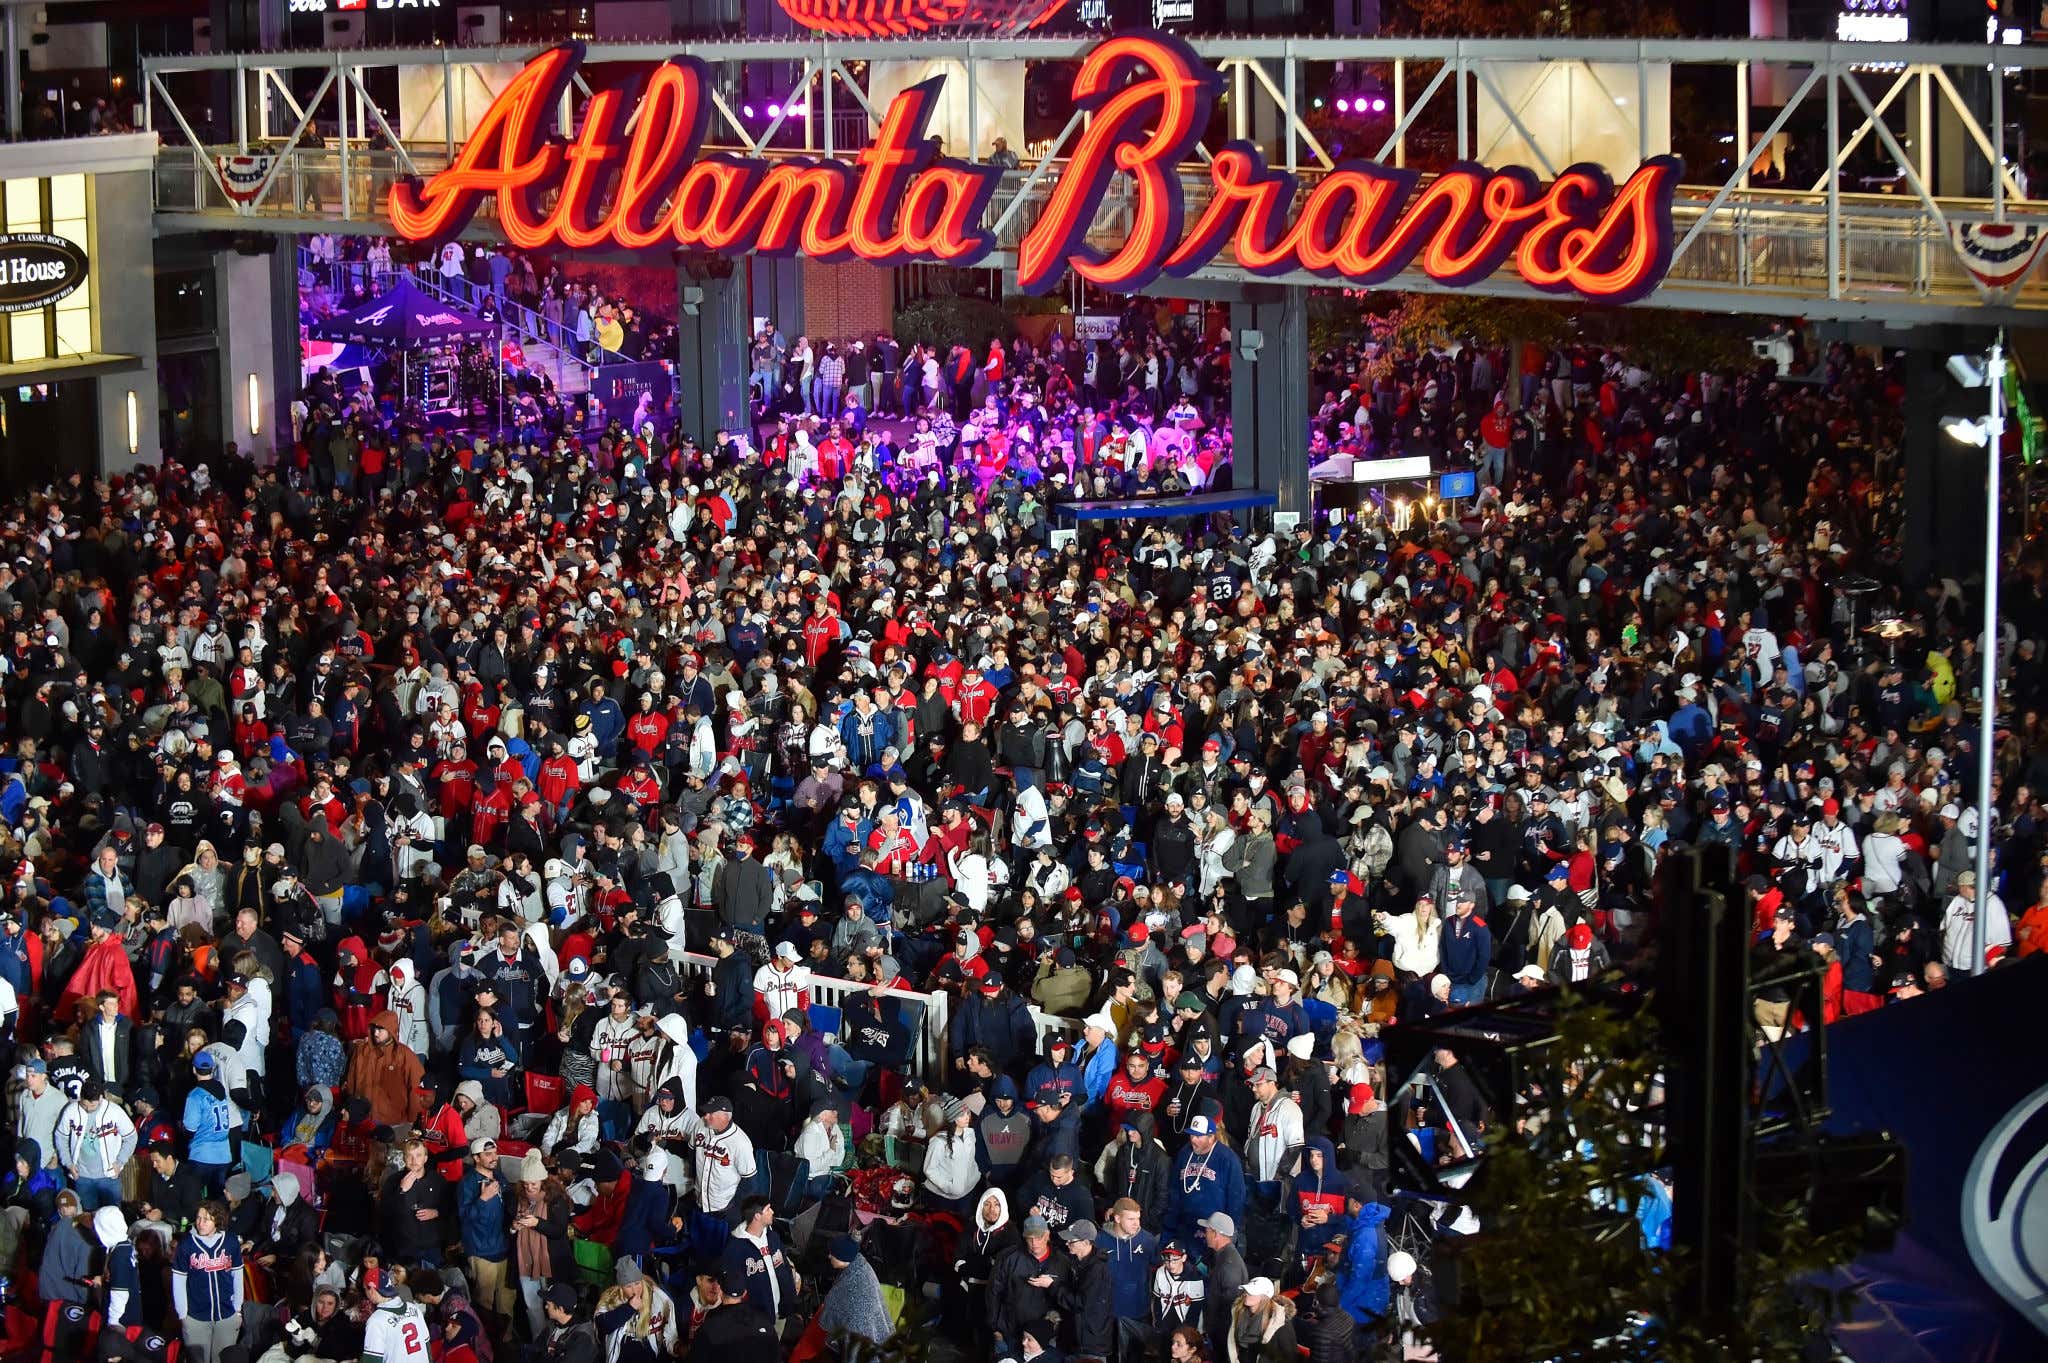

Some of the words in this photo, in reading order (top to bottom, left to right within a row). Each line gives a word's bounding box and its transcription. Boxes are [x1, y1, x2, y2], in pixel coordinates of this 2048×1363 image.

[388, 42, 990, 264] Atlanta
[1017, 34, 1676, 298] Braves
[18, 234, 46, 243] CLASSIC
[47, 235, 68, 248] ROCK
[11, 257, 66, 284] House
[43, 294, 60, 305] DRAFT
[1213, 583, 1232, 600] 23
[493, 966, 529, 981] Atlanta
[767, 981, 794, 991] Braves
[474, 1047, 506, 1064] Atlanta
[58, 1079, 83, 1100] 13
[1112, 1086, 1150, 1103] Braves
[213, 1105, 230, 1129] 13
[1000, 1125, 1010, 1133] A
[696, 1133, 727, 1153] Braves
[1302, 1199, 1330, 1212] Braves
[1132, 1244, 1143, 1254] A
[190, 1249, 232, 1270] Atlanta
[402, 1322, 422, 1355] 2
